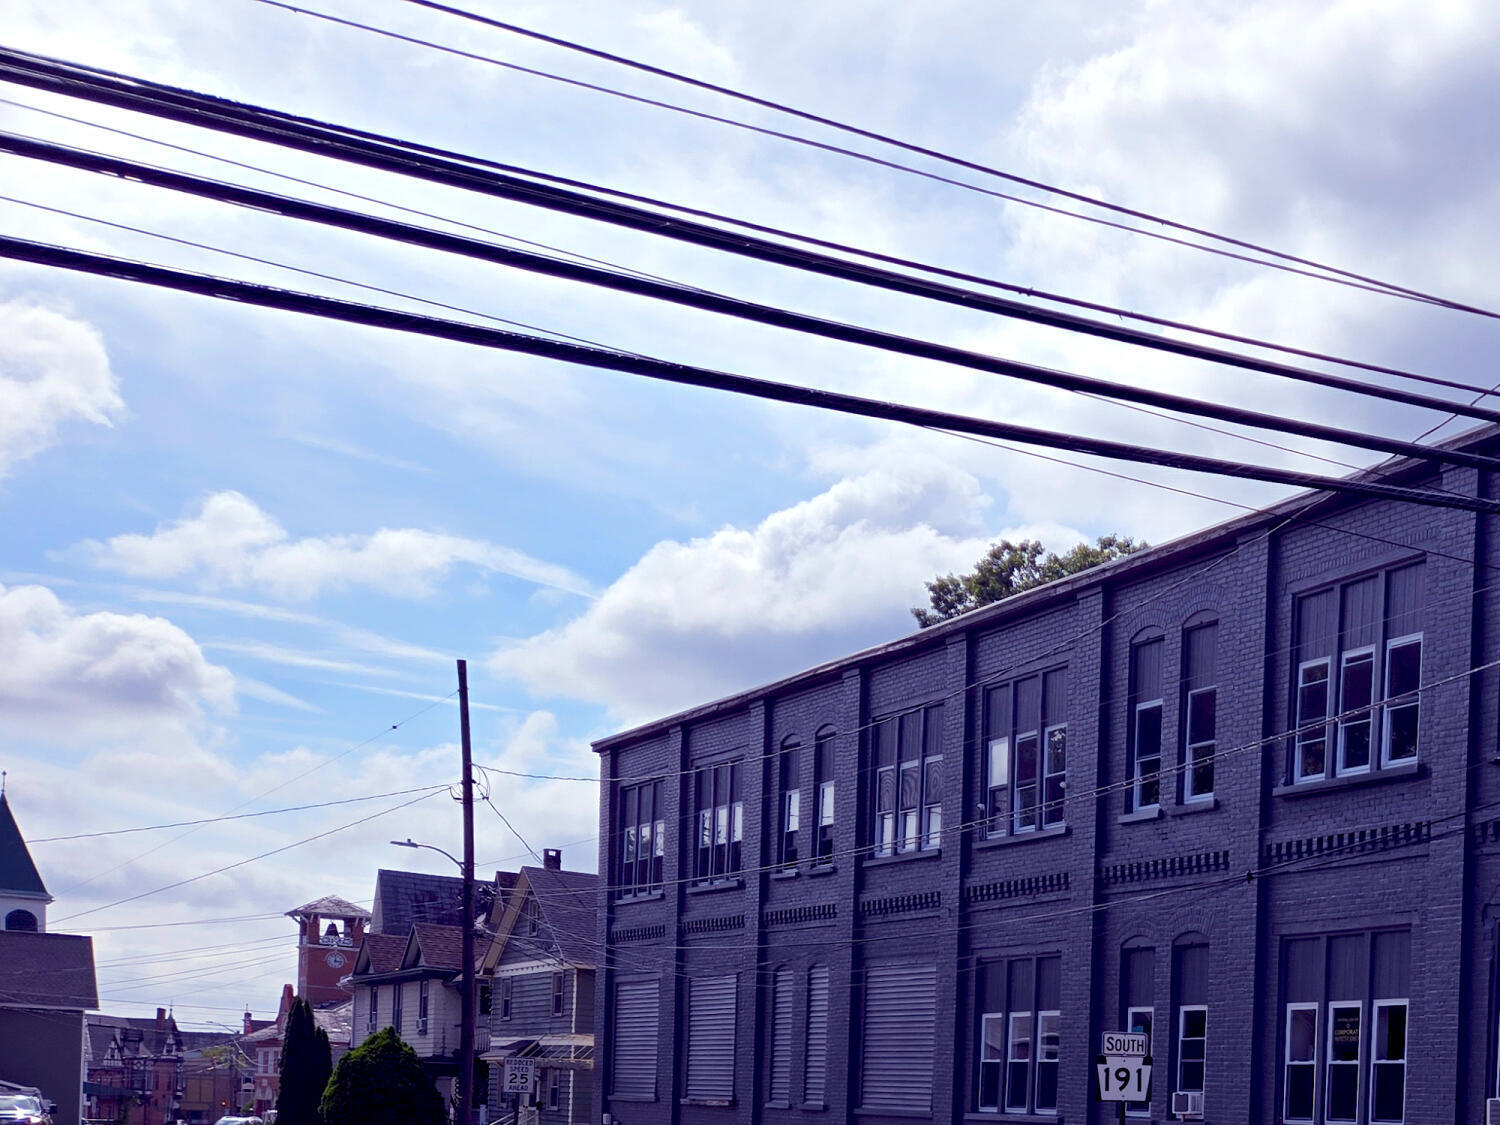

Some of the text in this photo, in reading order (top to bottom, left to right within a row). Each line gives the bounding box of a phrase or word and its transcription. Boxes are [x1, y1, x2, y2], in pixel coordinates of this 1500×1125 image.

[1106, 1036, 1144, 1052] SOUTH
[509, 1073, 529, 1085] 25
[1104, 1067, 1142, 1092] 191
